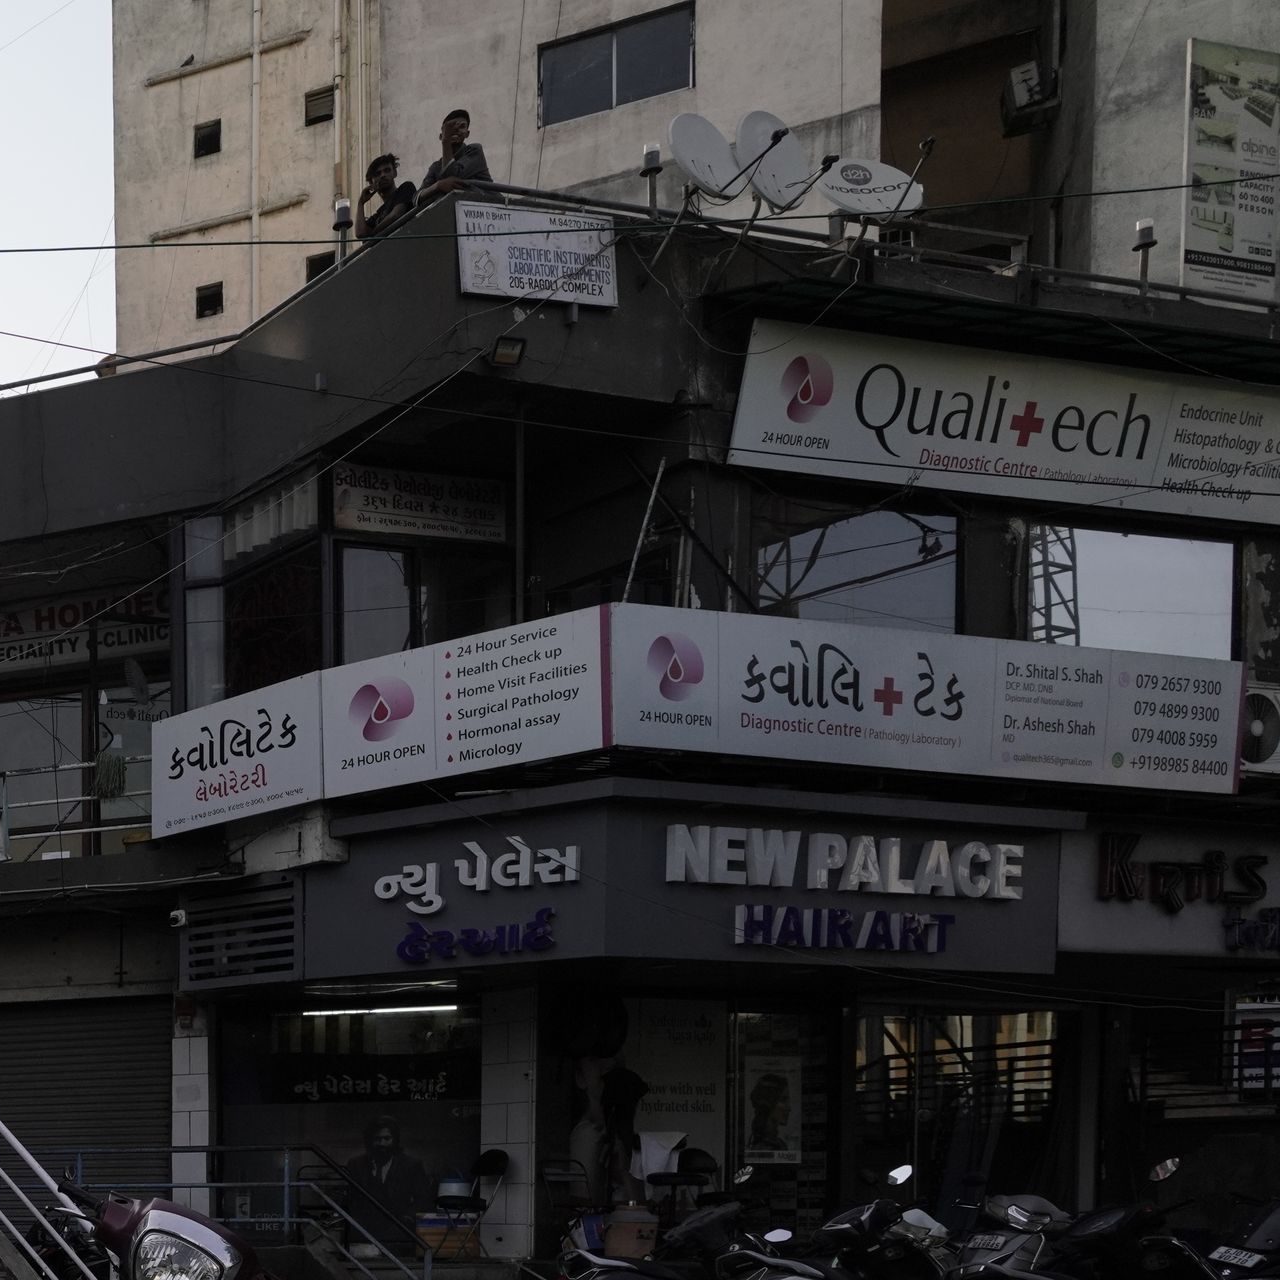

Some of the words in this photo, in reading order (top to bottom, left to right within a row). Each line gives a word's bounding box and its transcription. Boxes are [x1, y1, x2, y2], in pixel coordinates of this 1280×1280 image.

[1239, 180, 1274, 193] CAPACITY
[1238, 203, 1274, 216] PERSON
[507, 246, 551, 263] SCIENTIFIC
[553, 251, 611, 270] INSTRUMENTS
[1180, 403, 1237, 425] Endocrine
[1239, 409, 1263, 427] Unit
[919, 448, 991, 475] Diagnostic
[994, 456, 1038, 478] Centre
[457, 645, 472, 658] 24
[475, 638, 506, 655] Hour
[511, 624, 557, 647] Service
[457, 683, 494, 700] Home
[499, 673, 525, 692] Visit
[529, 661, 587, 685] Facilities
[1007, 662, 1023, 677] Dr.
[1026, 663, 1058, 680] Shital
[1061, 667, 1072, 681] S.
[1075, 668, 1102, 684] Shah
[1135, 674, 1158, 690] 079
[1160, 675, 1190, 692] 2657
[1192, 678, 1221, 695] 9300
[457, 700, 508, 721] Surgical
[511, 686, 579, 714] Pathology
[458, 719, 522, 741] Hormonal
[526, 711, 560, 729] assay
[1004, 715, 1020, 730] Dr.
[1023, 715, 1064, 734] Ashesh
[1067, 719, 1095, 736] Shah
[341, 758, 354, 770] 24
[357, 750, 389, 767] HOUR
[391, 744, 425, 762] OPEN
[459, 740, 523, 763] Micrology
[1190, 759, 1227, 776] 84400
[665, 823, 802, 888] NEW
[807, 833, 1024, 900] PALACE
[374, 863, 446, 915] ન્યુ
[455, 836, 580, 891] પેલેસ
[734, 903, 853, 948] HAIR
[854, 911, 955, 953] ART
[640, 1099, 688, 1113] hydrated
[690, 1101, 714, 1112] skin.
